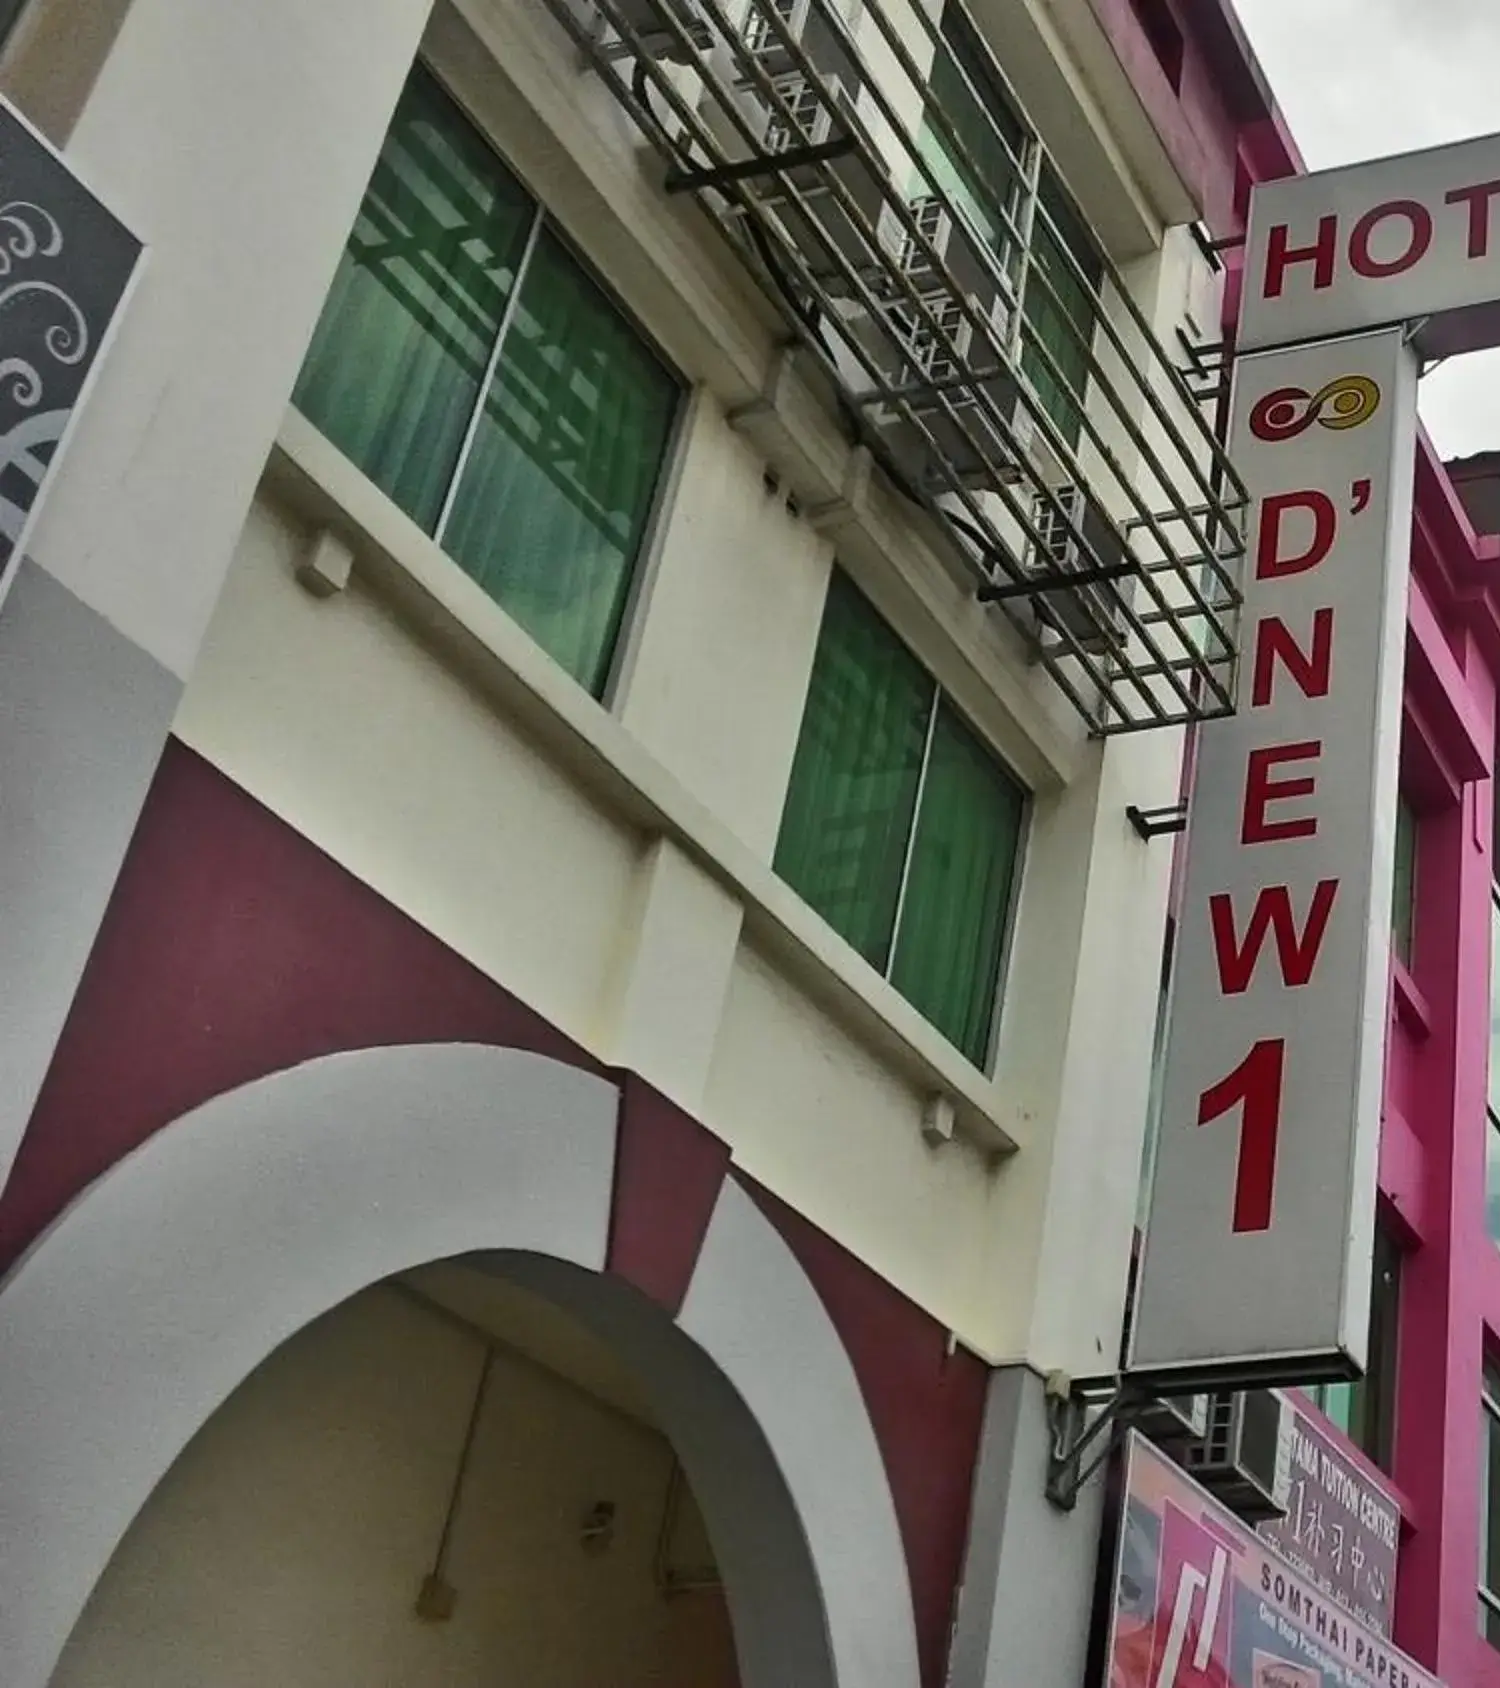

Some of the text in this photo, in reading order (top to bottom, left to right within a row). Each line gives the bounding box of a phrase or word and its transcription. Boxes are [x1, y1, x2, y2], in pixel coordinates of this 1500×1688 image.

[1196, 1036, 1288, 1236] 1
[1320, 1453, 1361, 1519] TUITION
[1360, 1489, 1396, 1551] CENTRE
[1260, 1562, 1348, 1653] SOMTHAI
